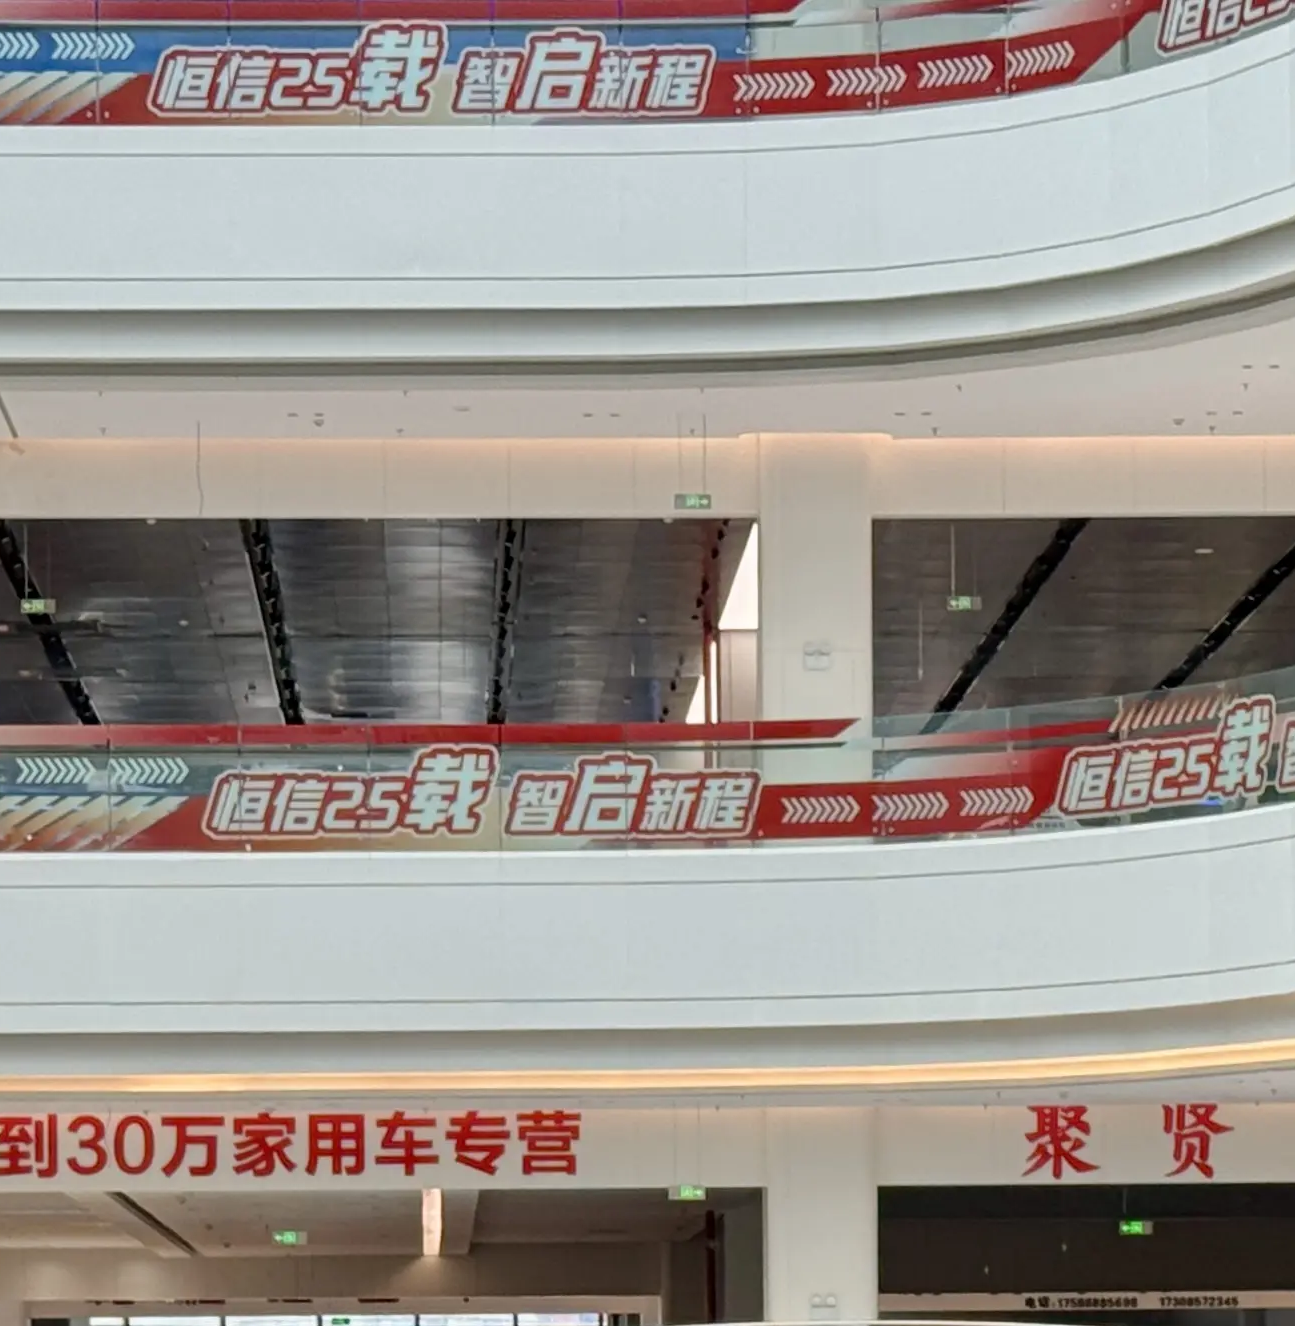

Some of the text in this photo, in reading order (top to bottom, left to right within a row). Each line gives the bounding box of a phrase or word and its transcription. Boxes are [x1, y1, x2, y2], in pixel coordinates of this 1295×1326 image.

[159, 24, 708, 112] 恒信25载 智启新程
[210, 750, 756, 834] 恒信25载 智启新程
[1065, 701, 1270, 812] 恒信25载
